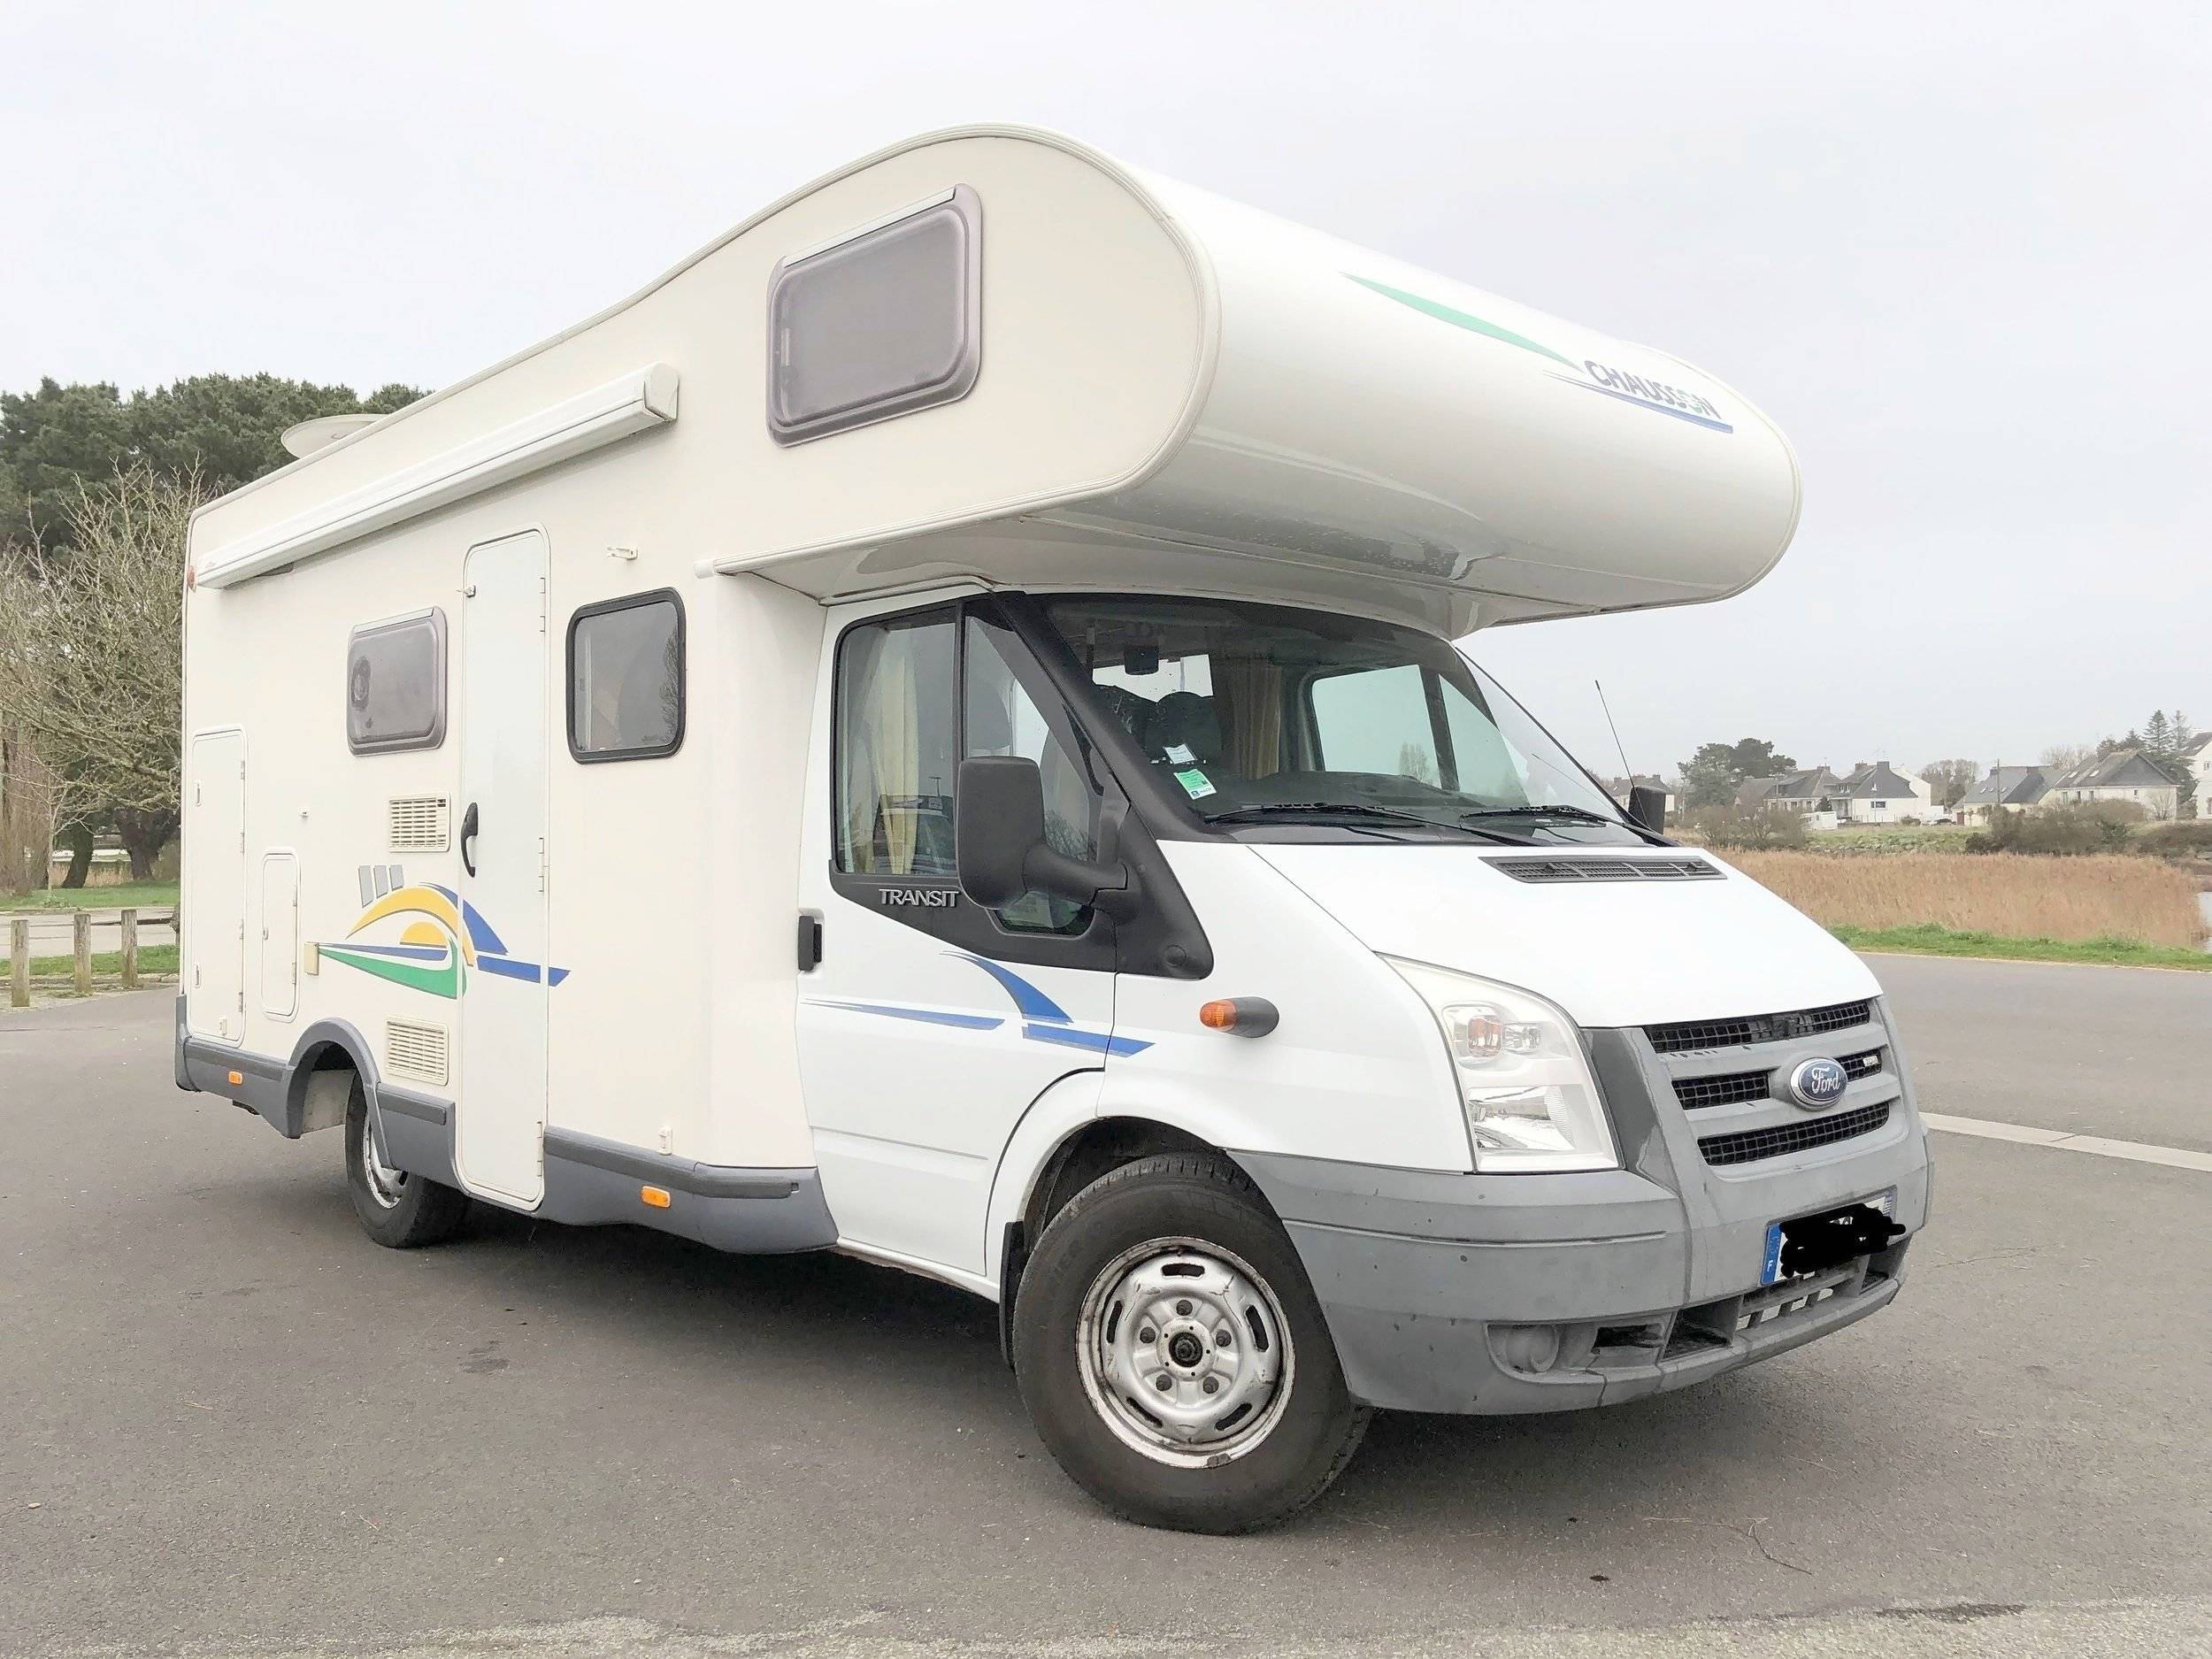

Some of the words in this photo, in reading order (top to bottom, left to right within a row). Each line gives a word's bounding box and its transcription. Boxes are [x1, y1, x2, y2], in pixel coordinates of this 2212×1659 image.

[1585, 360, 1721, 419] CHAUSSON
[879, 888, 959, 907] TRANSIT
[1812, 1067, 1840, 1094] Ford
[1767, 1259, 1773, 1272] F
